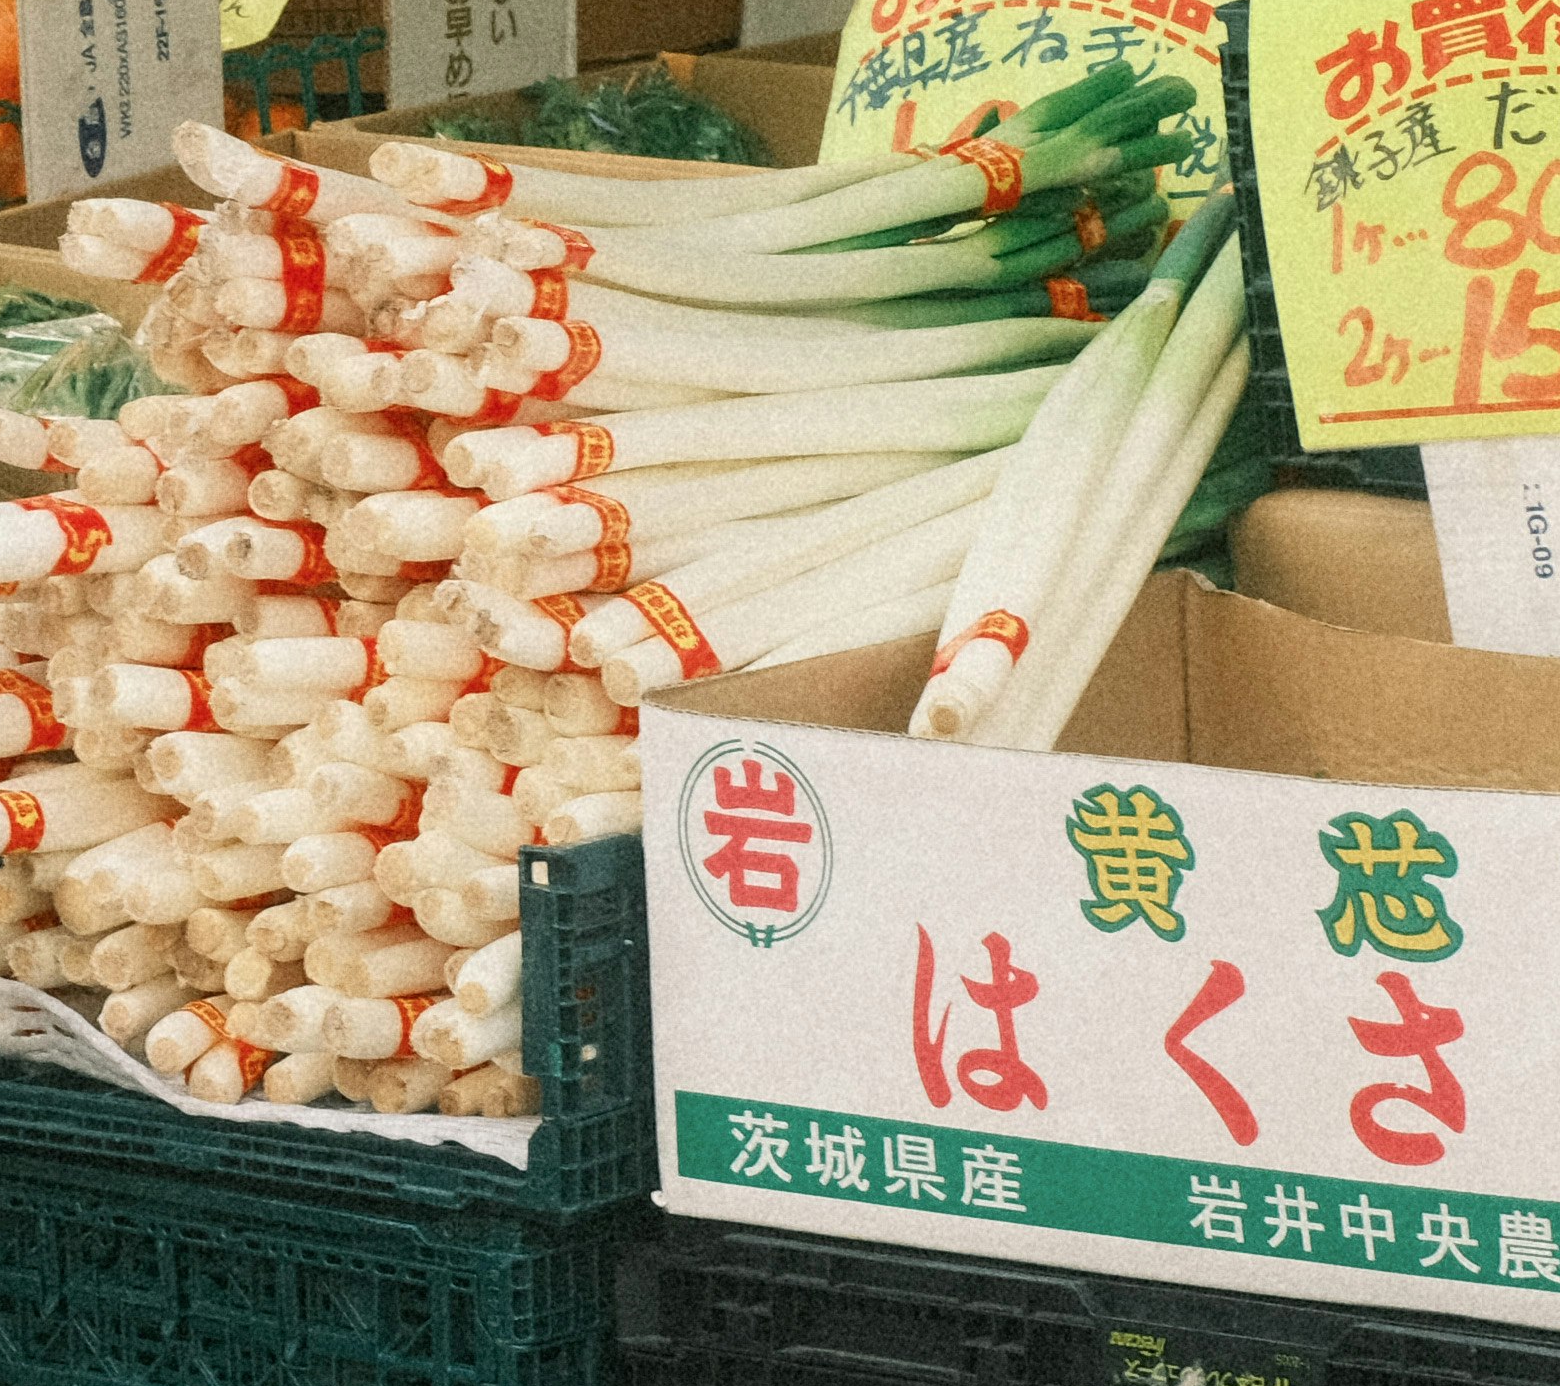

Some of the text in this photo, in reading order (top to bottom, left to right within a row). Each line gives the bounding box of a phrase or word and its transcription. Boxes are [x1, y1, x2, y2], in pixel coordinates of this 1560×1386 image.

[700, 757, 814, 916] 岩
[724, 1108, 1030, 1216] 茨城県産
